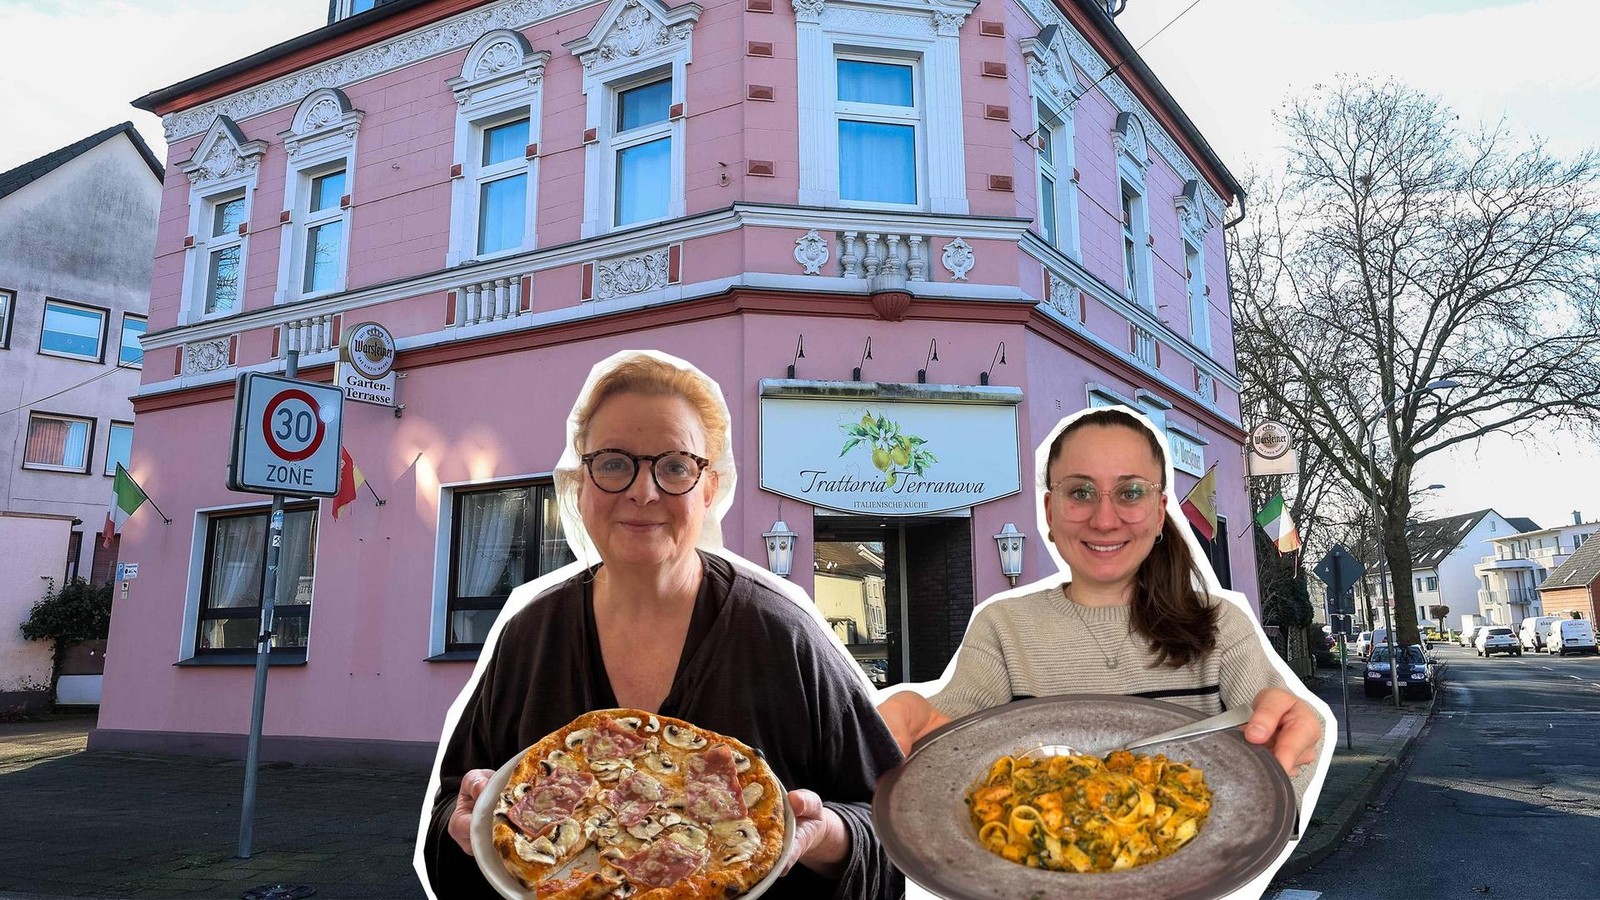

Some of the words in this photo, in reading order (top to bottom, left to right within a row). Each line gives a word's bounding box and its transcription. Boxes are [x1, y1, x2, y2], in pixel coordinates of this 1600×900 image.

[355, 340, 392, 358] Warsteiner
[346, 375, 391, 391] Garten-
[344, 386, 391, 404] Terrasse
[275, 407, 312, 443] 30
[1254, 433, 1287, 445] Warsteiner
[266, 464, 314, 486] ZONE
[799, 470, 888, 494] Trattoria
[891, 471, 986, 494] Terranova
[853, 501, 903, 509] ITALIENISCHE
